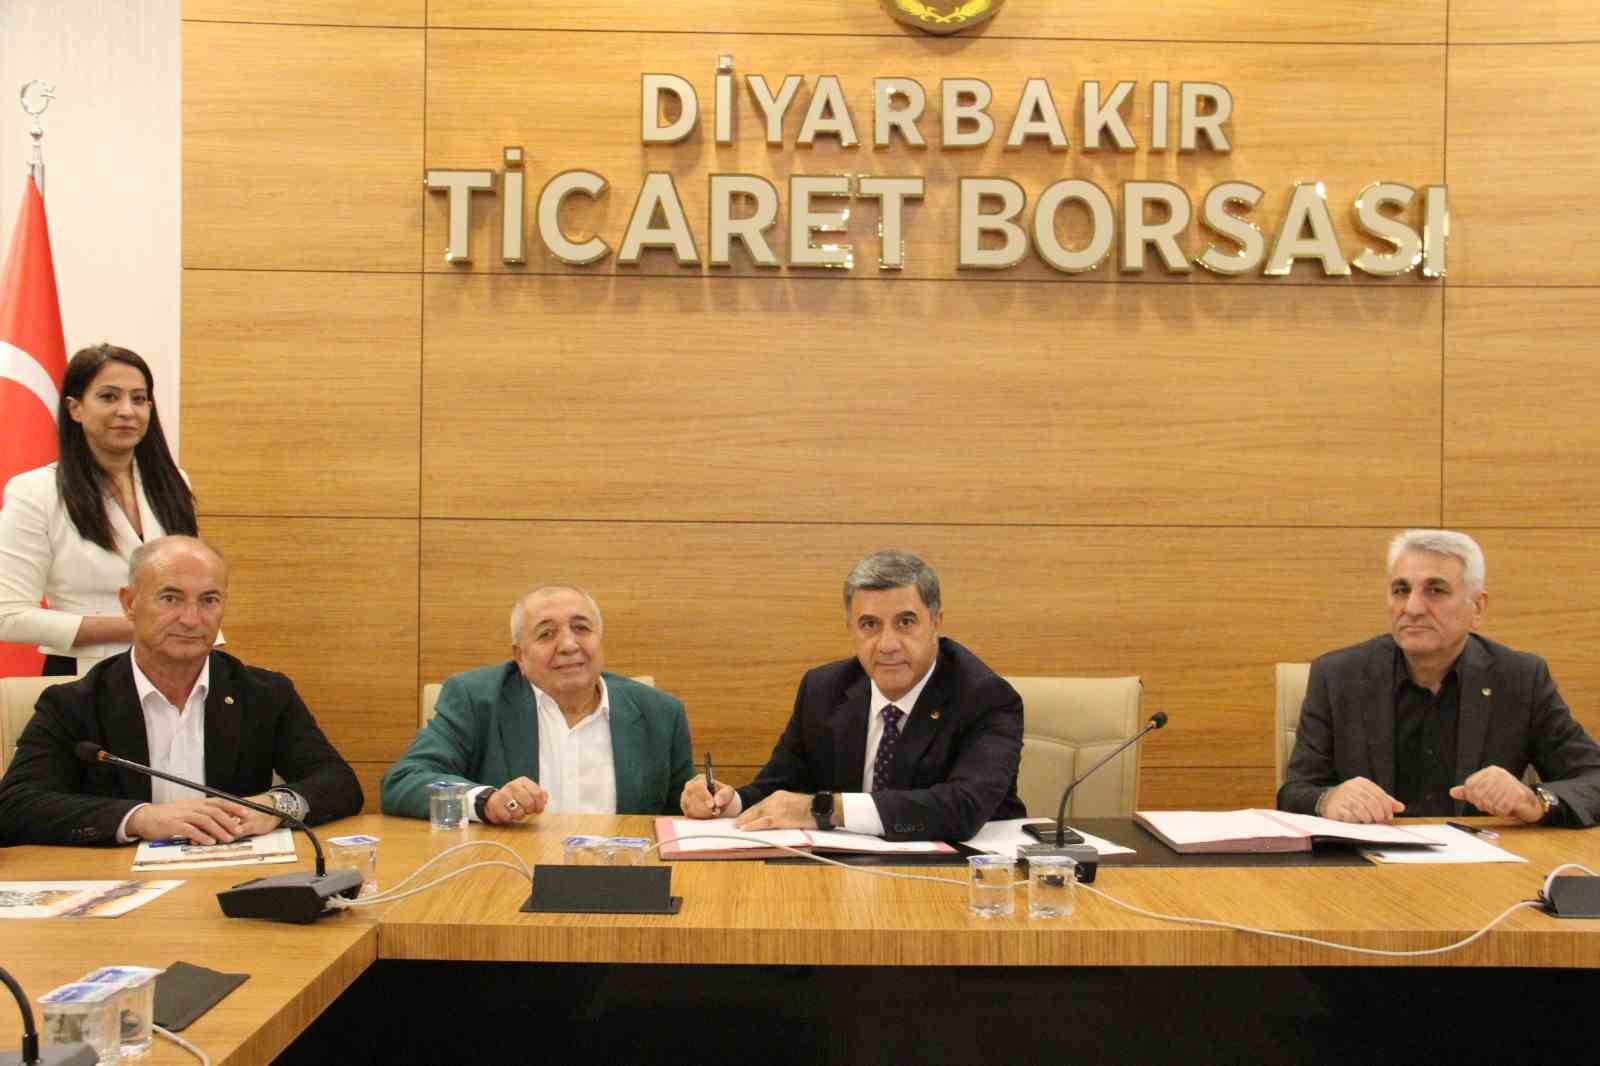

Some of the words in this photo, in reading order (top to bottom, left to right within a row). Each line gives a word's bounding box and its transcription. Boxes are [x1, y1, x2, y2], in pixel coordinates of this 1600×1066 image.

[641, 55, 1233, 153] DİYARBAKIR
[424, 147, 924, 270] TİCARET
[957, 177, 1448, 279] BORSASI
